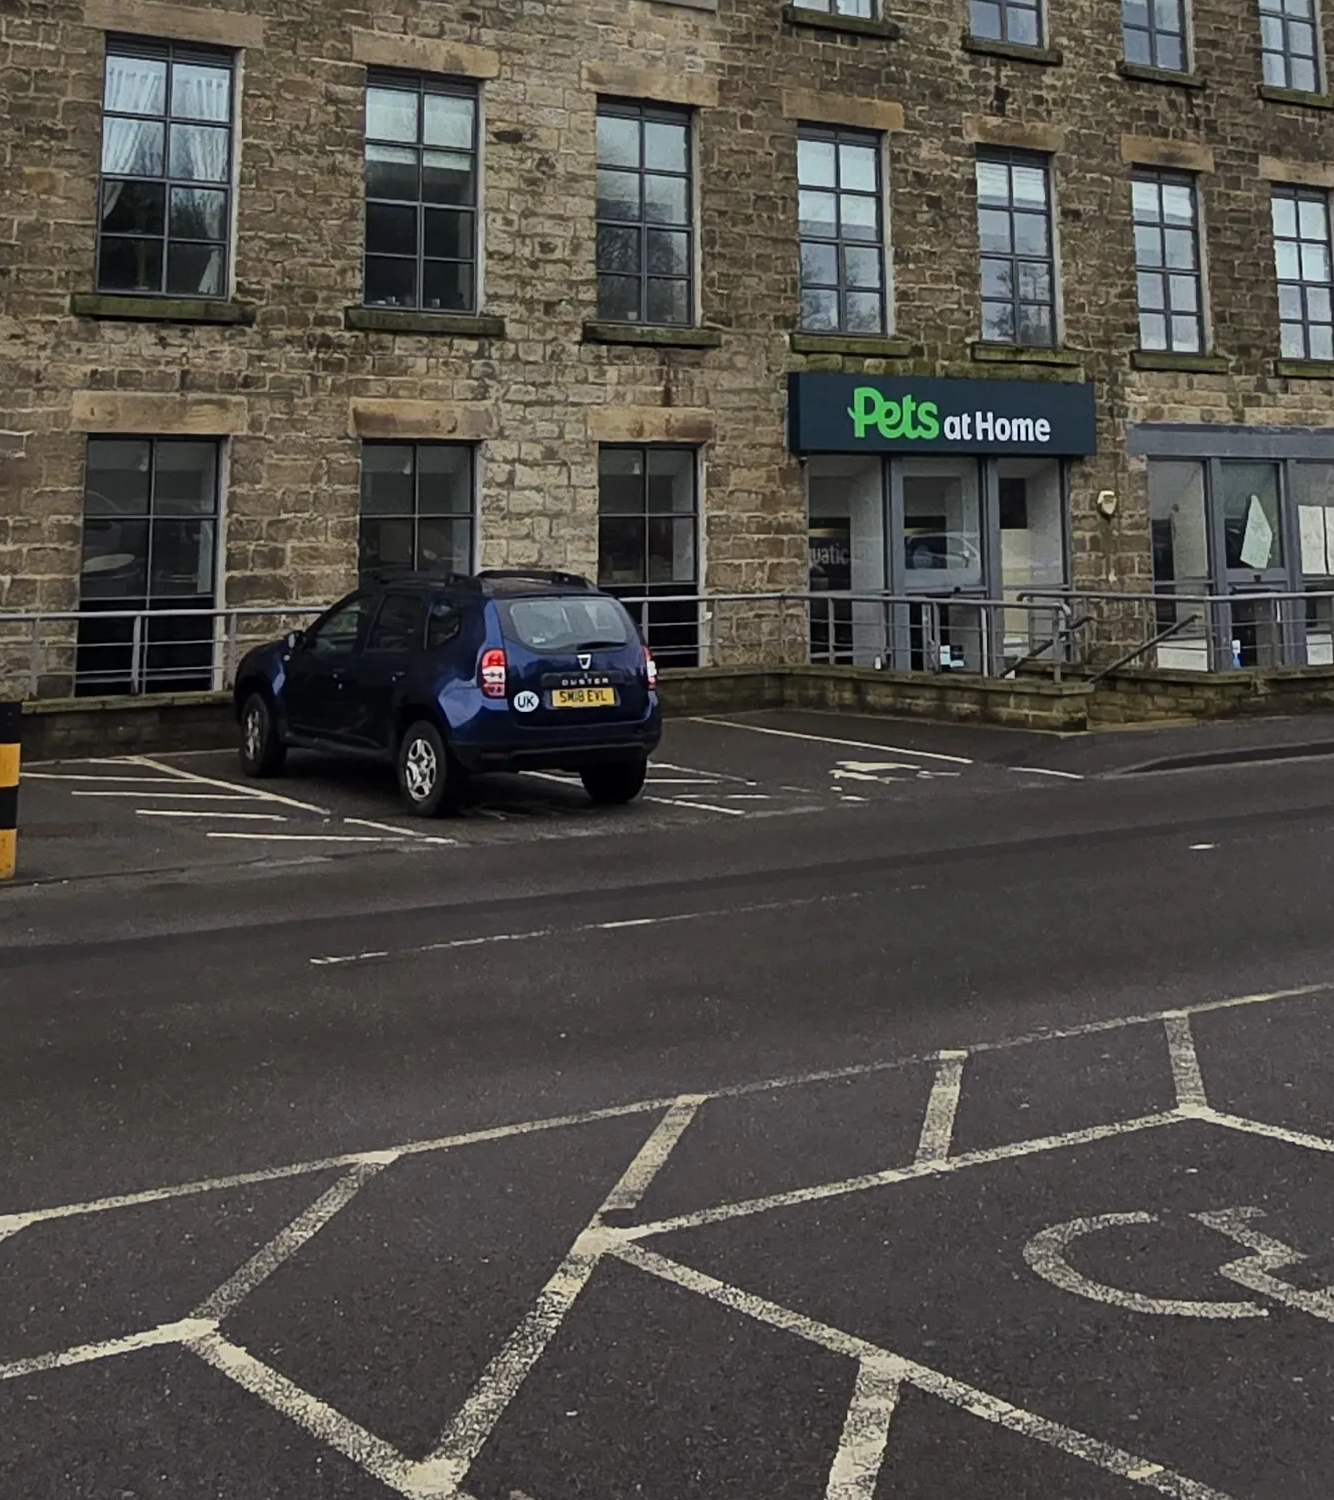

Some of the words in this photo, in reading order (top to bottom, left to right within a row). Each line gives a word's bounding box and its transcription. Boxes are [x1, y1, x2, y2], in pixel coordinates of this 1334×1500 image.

[847, 387, 940, 440] Pets
[943, 413, 973, 441] at
[975, 411, 1052, 442] Home
[562, 678, 609, 686] DUSTER
[517, 695, 535, 709] UK
